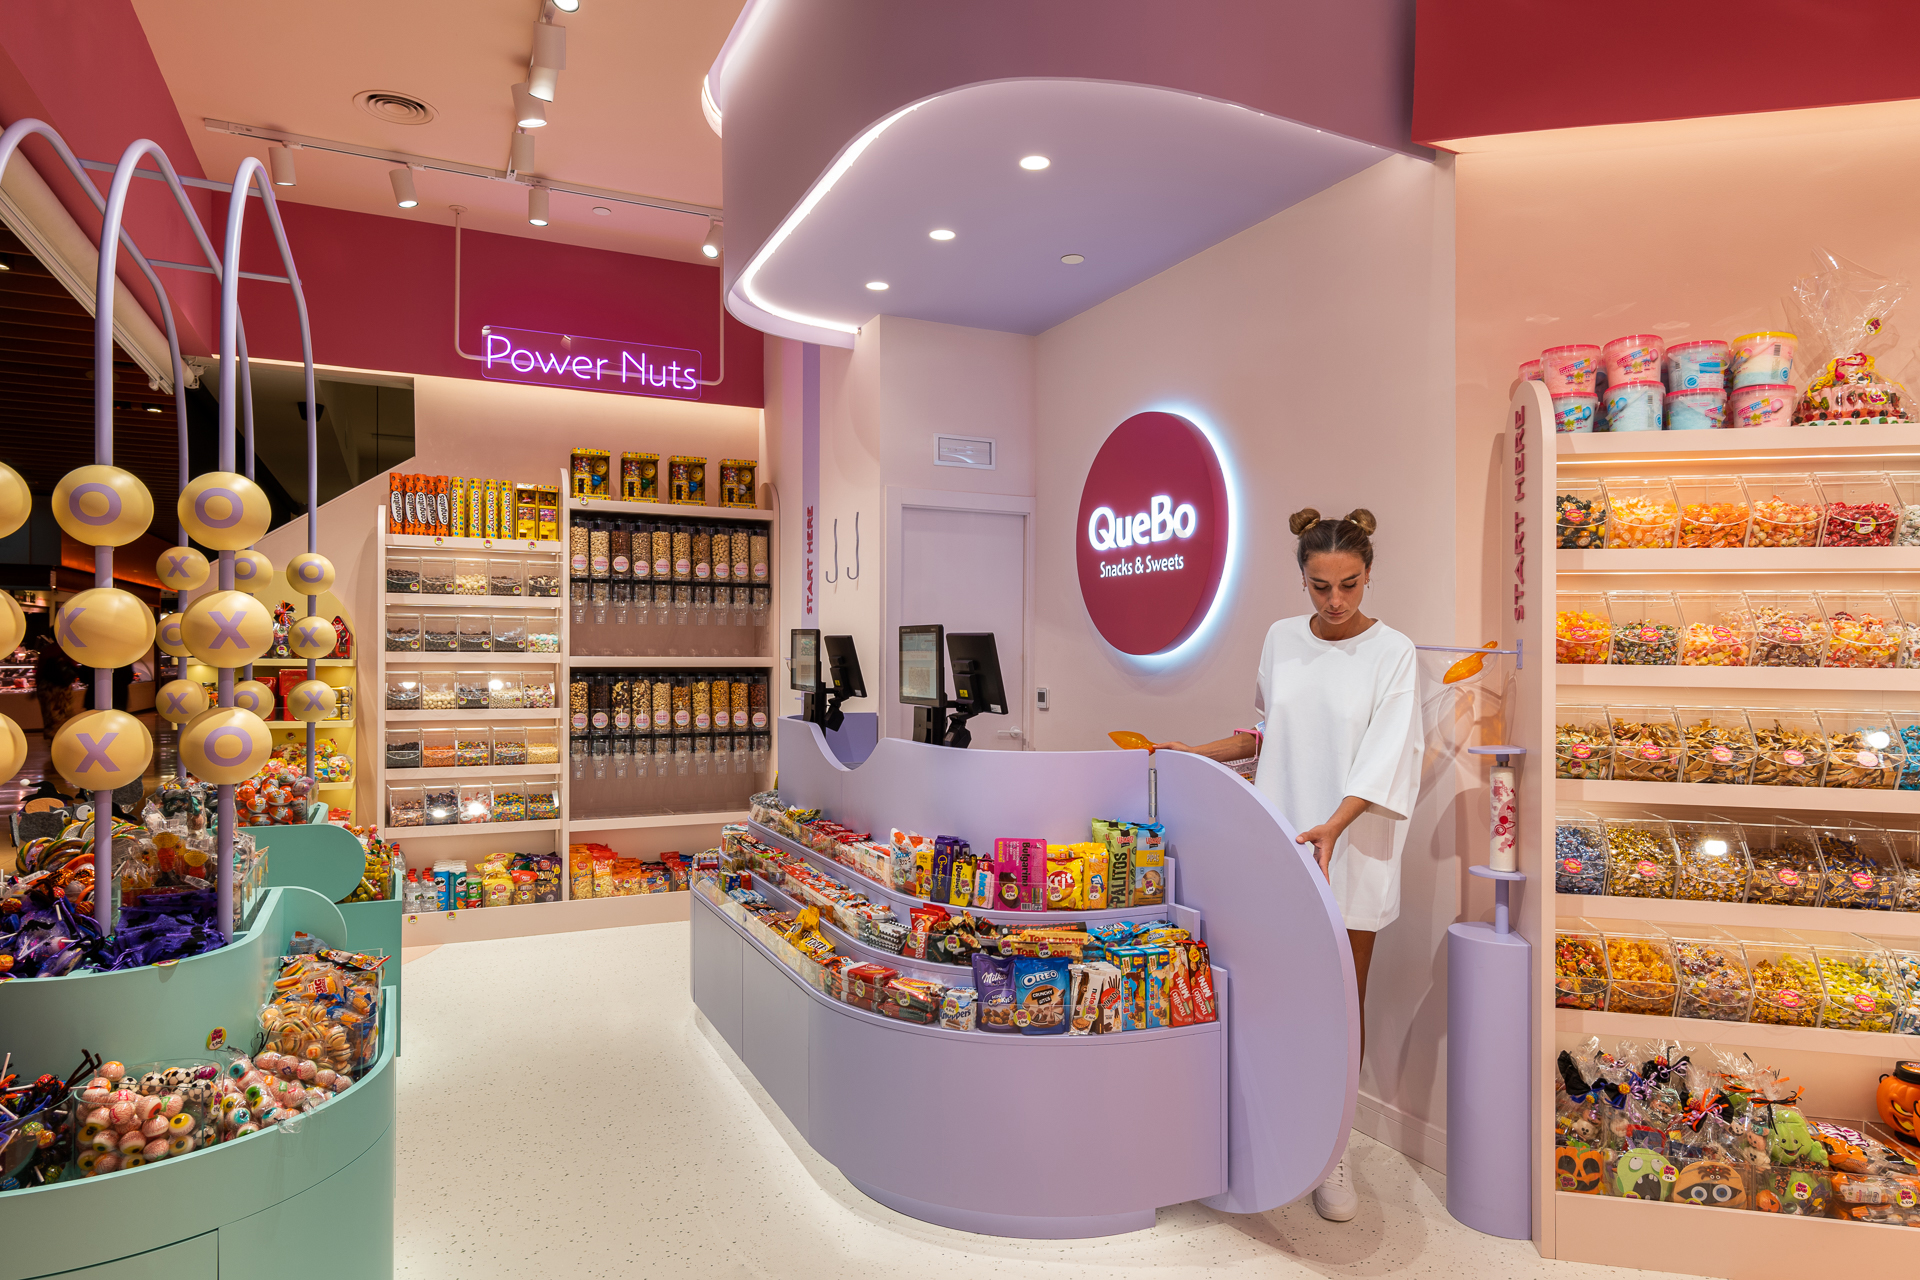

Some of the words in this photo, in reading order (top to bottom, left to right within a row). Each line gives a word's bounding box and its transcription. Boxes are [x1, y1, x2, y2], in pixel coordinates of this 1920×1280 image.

[487, 334, 609, 381] Power
[621, 350, 698, 390] Nuts
[1514, 404, 1526, 504] HERE
[1088, 494, 1197, 552] QueBo
[167, 556, 190, 578] X
[1100, 558, 1133, 578] Snacks
[1134, 556, 1144, 574] &
[1146, 554, 1184, 573] Sweets
[1514, 511, 1525, 624] START
[208, 610, 250, 650] X
[298, 626, 321, 648] X
[166, 692, 189, 714] X
[303, 690, 326, 711] X
[75, 732, 120, 772] X
[204, 726, 253, 768] O
[1020, 842, 1030, 887] Bulgarino
[1110, 852, 1128, 906] PALITOS
[1028, 934, 1084, 945] TOBLERONE
[1016, 948, 1072, 958] TOBONE
[982, 972, 1008, 984] Milka
[1024, 970, 1058, 986] OREO
[1032, 989, 1054, 1000] CRUNCHY
[1038, 997, 1052, 1005] BITES
[1172, 992, 1186, 1016] nocilla
[1194, 990, 1208, 1016] nocilla
